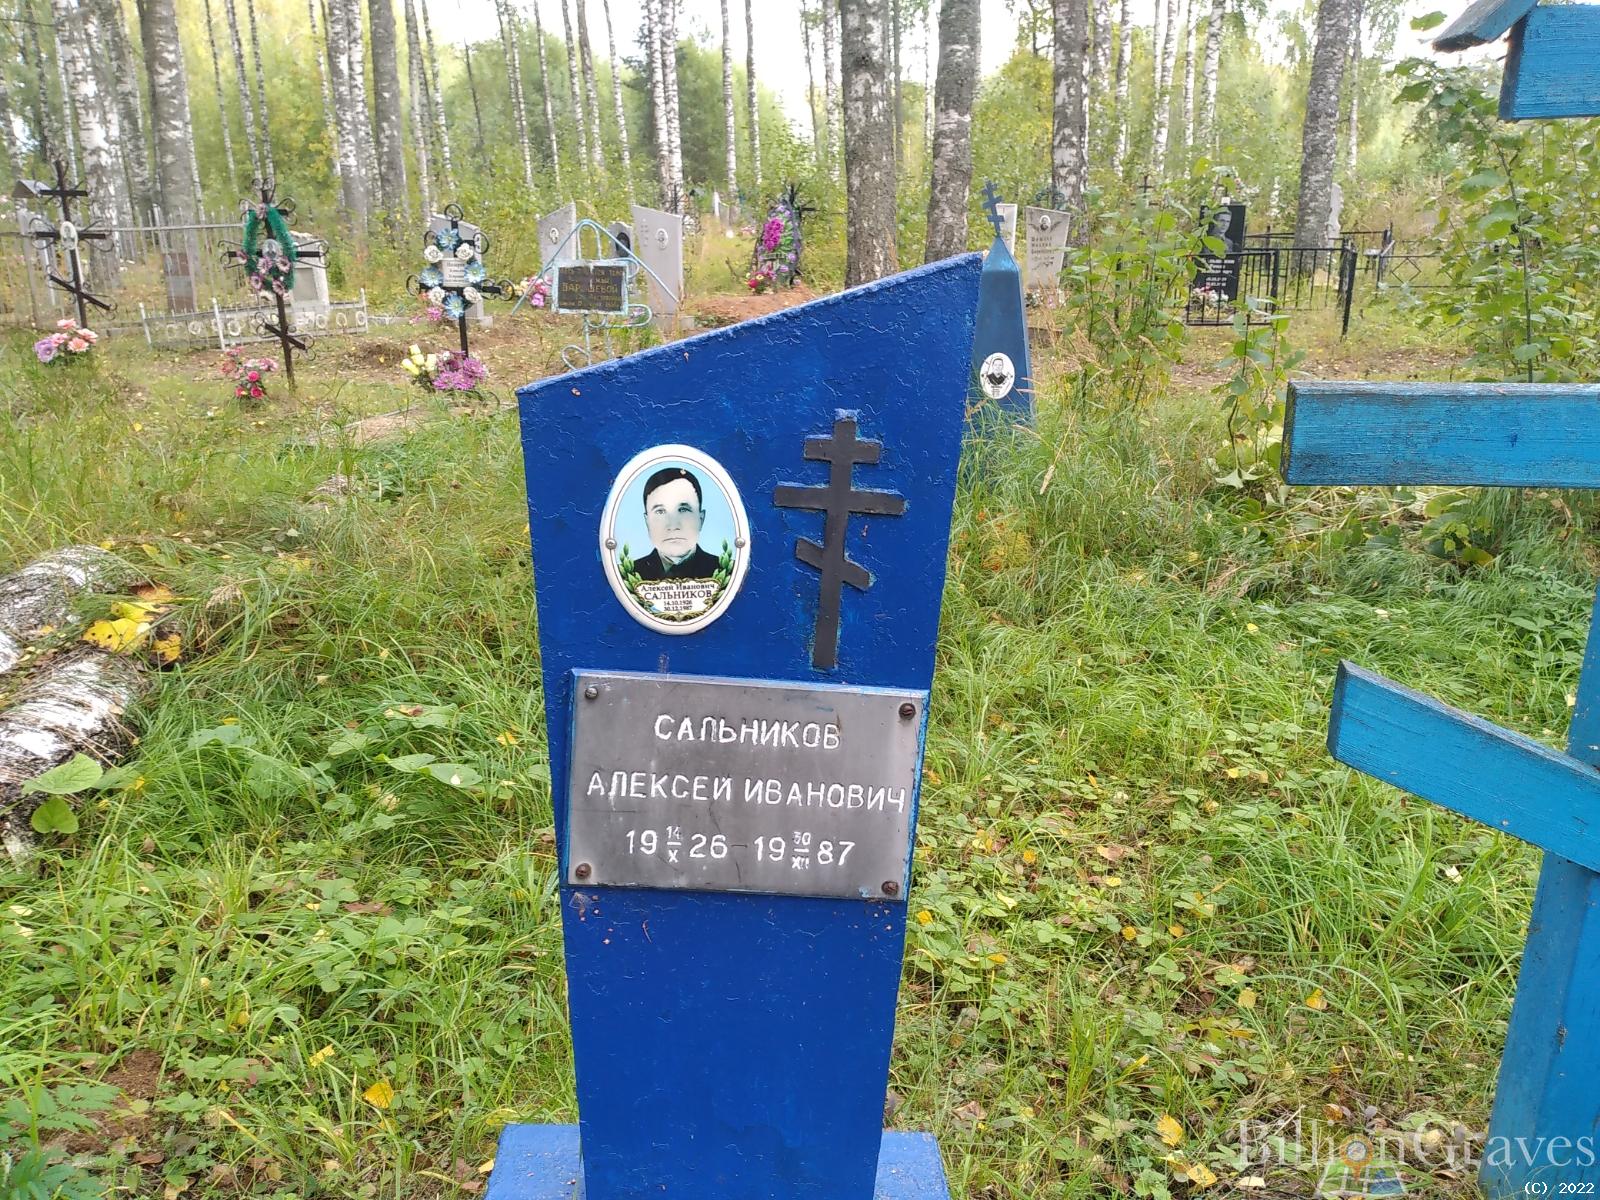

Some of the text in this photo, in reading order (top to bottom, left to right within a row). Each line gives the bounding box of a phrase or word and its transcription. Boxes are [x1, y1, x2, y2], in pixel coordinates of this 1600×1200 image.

[641, 583, 715, 592] Алексей Иванович
[644, 590, 712, 600] САЛЬНИКОВ
[654, 714, 840, 750] САЛЬНИКОВ
[587, 771, 906, 813] АЛЕКСЕЙ ИВАНОВИЧ
